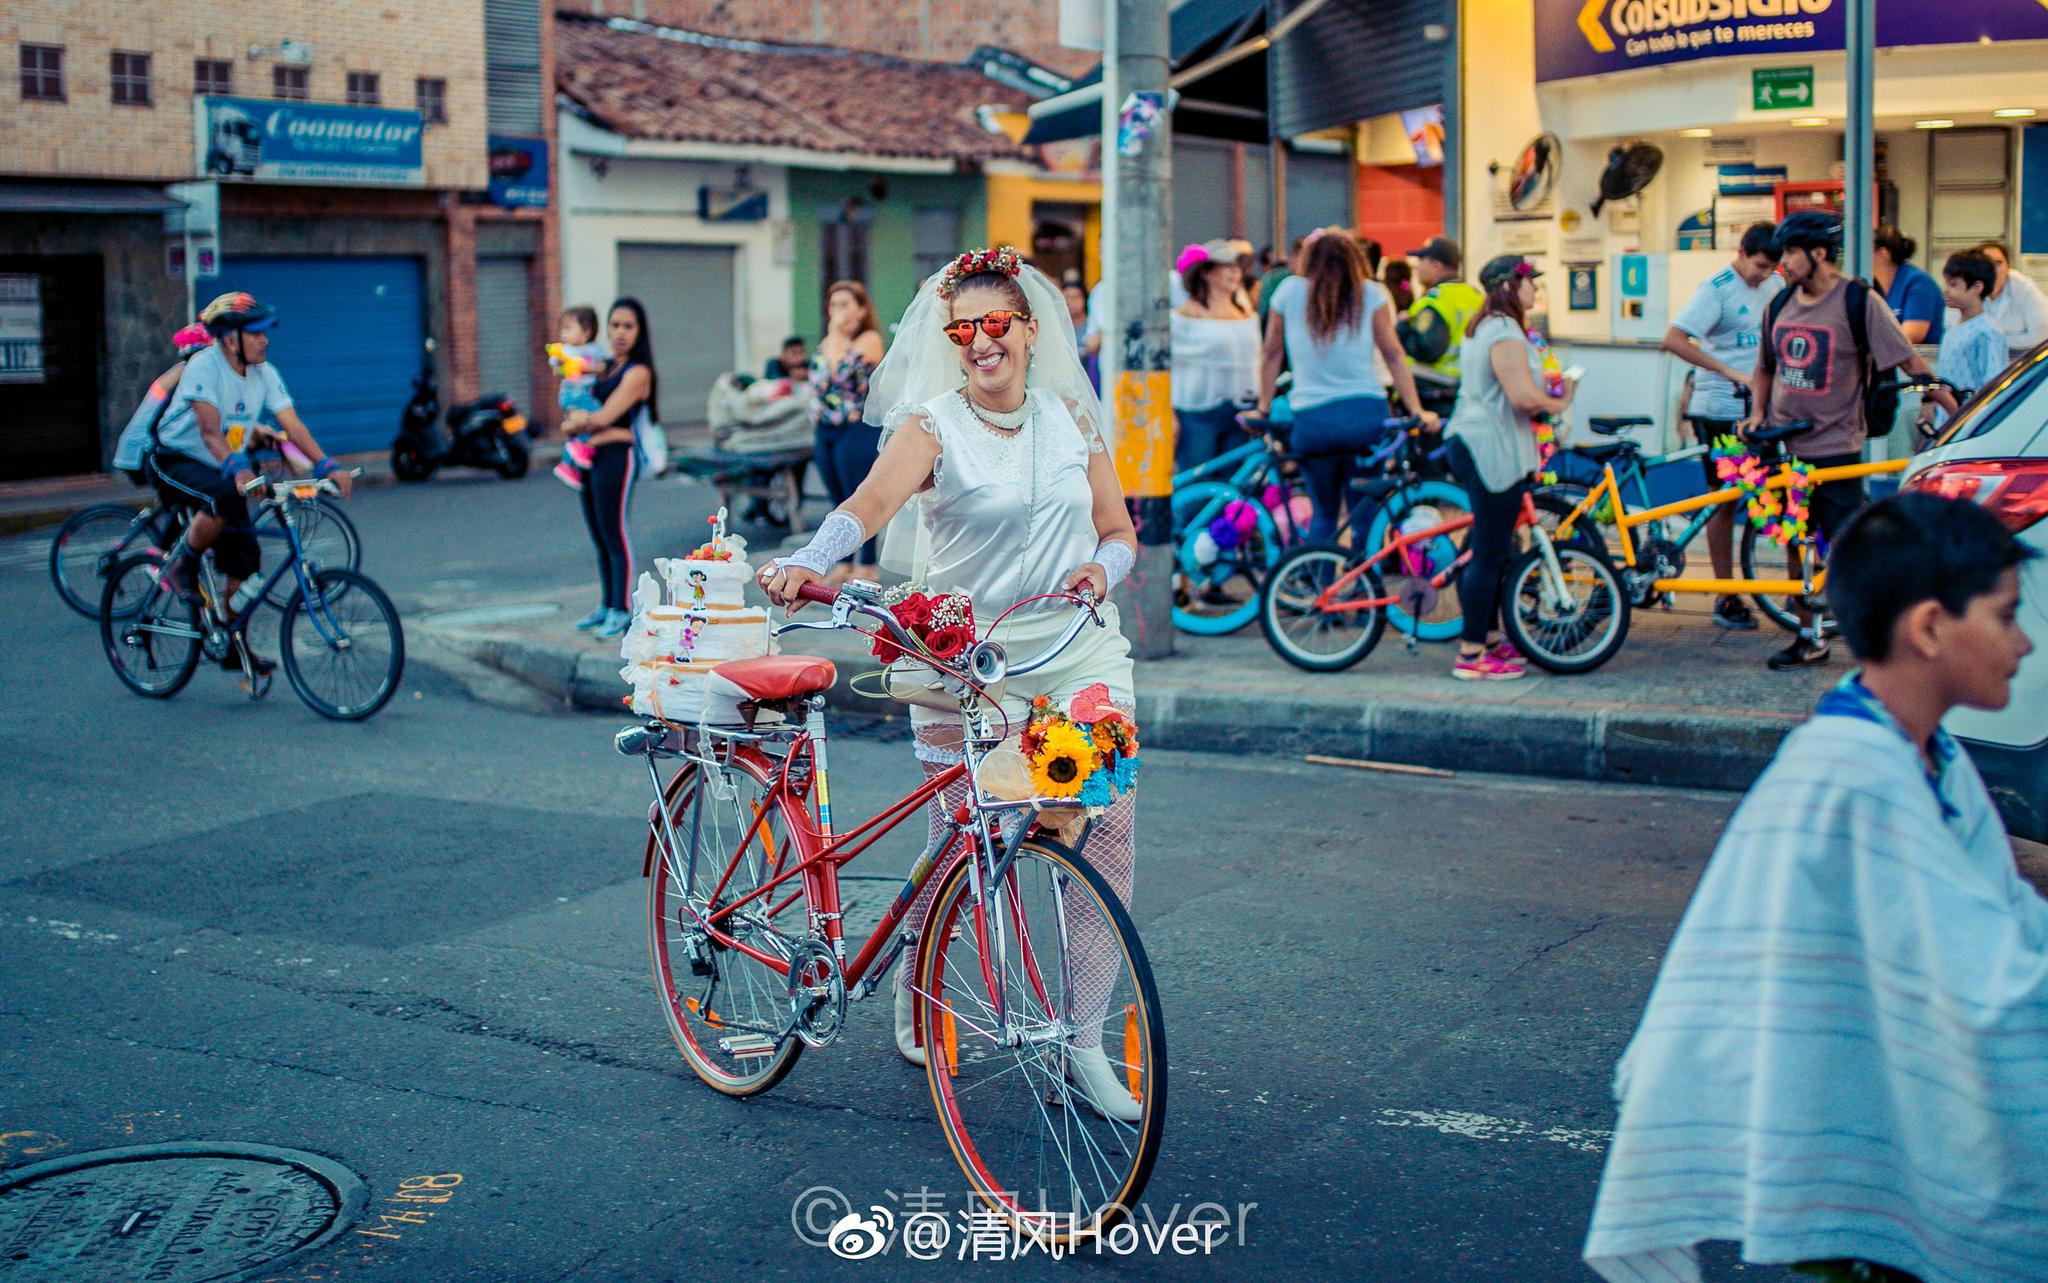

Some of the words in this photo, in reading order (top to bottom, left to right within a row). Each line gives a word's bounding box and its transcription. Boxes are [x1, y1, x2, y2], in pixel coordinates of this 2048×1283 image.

[1625, 38, 1649, 58] Con
[1649, 31, 1676, 54] todo
[1676, 29, 1689, 49] lo
[1690, 28, 1713, 50] que
[1714, 25, 1734, 43] te
[1737, 21, 1815, 42] mereces
[266, 107, 419, 143] Coomotor
